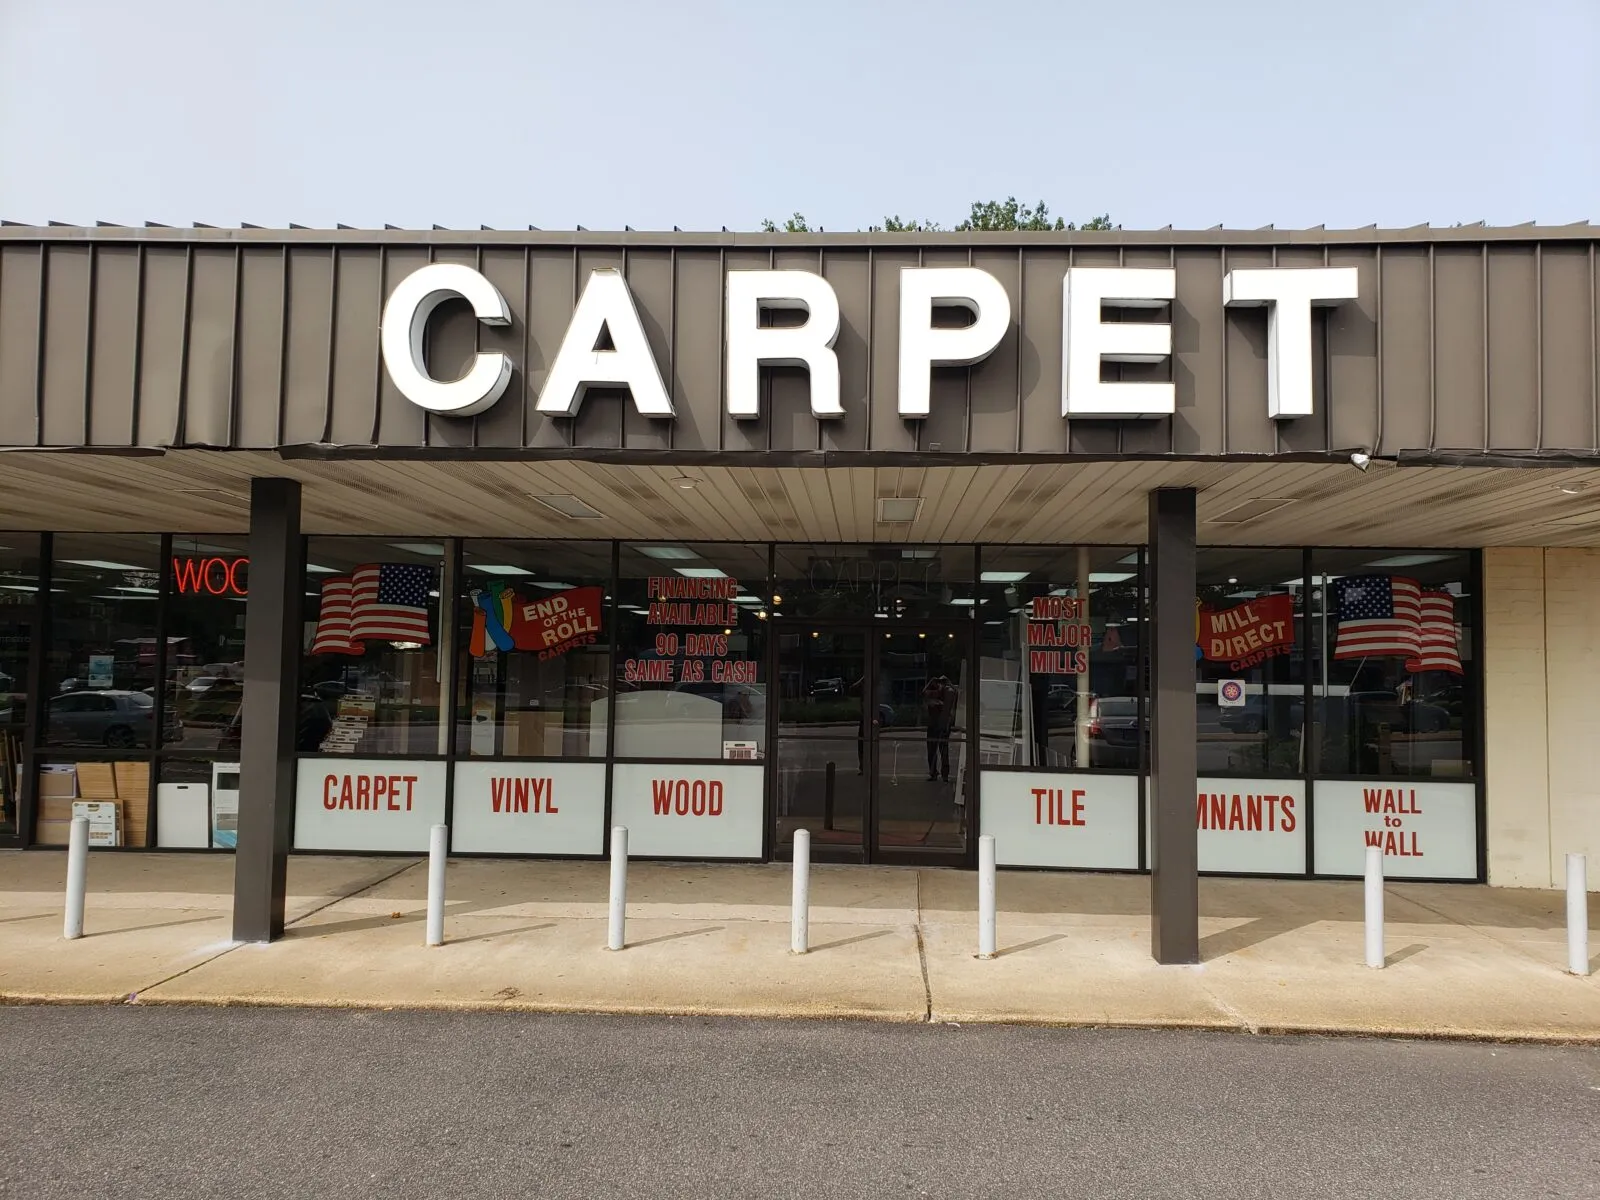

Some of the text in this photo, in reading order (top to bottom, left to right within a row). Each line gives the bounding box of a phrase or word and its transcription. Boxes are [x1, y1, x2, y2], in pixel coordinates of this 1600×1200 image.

[380, 263, 1359, 420] CARPET
[647, 576, 738, 599] FINANCING
[522, 596, 568, 622] END
[543, 607, 586, 628] OF THE
[647, 603, 738, 626] AVAILABLE
[1032, 597, 1086, 619] MOST
[1211, 605, 1260, 634] MILL
[541, 616, 598, 646] ROLL
[1027, 624, 1092, 646] MAJOR
[1211, 621, 1286, 657] DIRECT
[538, 633, 597, 662] CARPETS
[655, 633, 728, 656] 90 DAYS
[624, 659, 757, 683] SAME AS CASH
[1030, 651, 1087, 674] MILLS
[1230, 644, 1291, 672] CARPETS
[324, 774, 418, 811] CARPET
[491, 777, 559, 814] VINYL
[652, 779, 724, 817] WOOD
[1363, 789, 1422, 814] WALL
[1031, 788, 1086, 826] TILE
[1384, 815, 1402, 828] to
[1364, 830, 1424, 857] WALL
